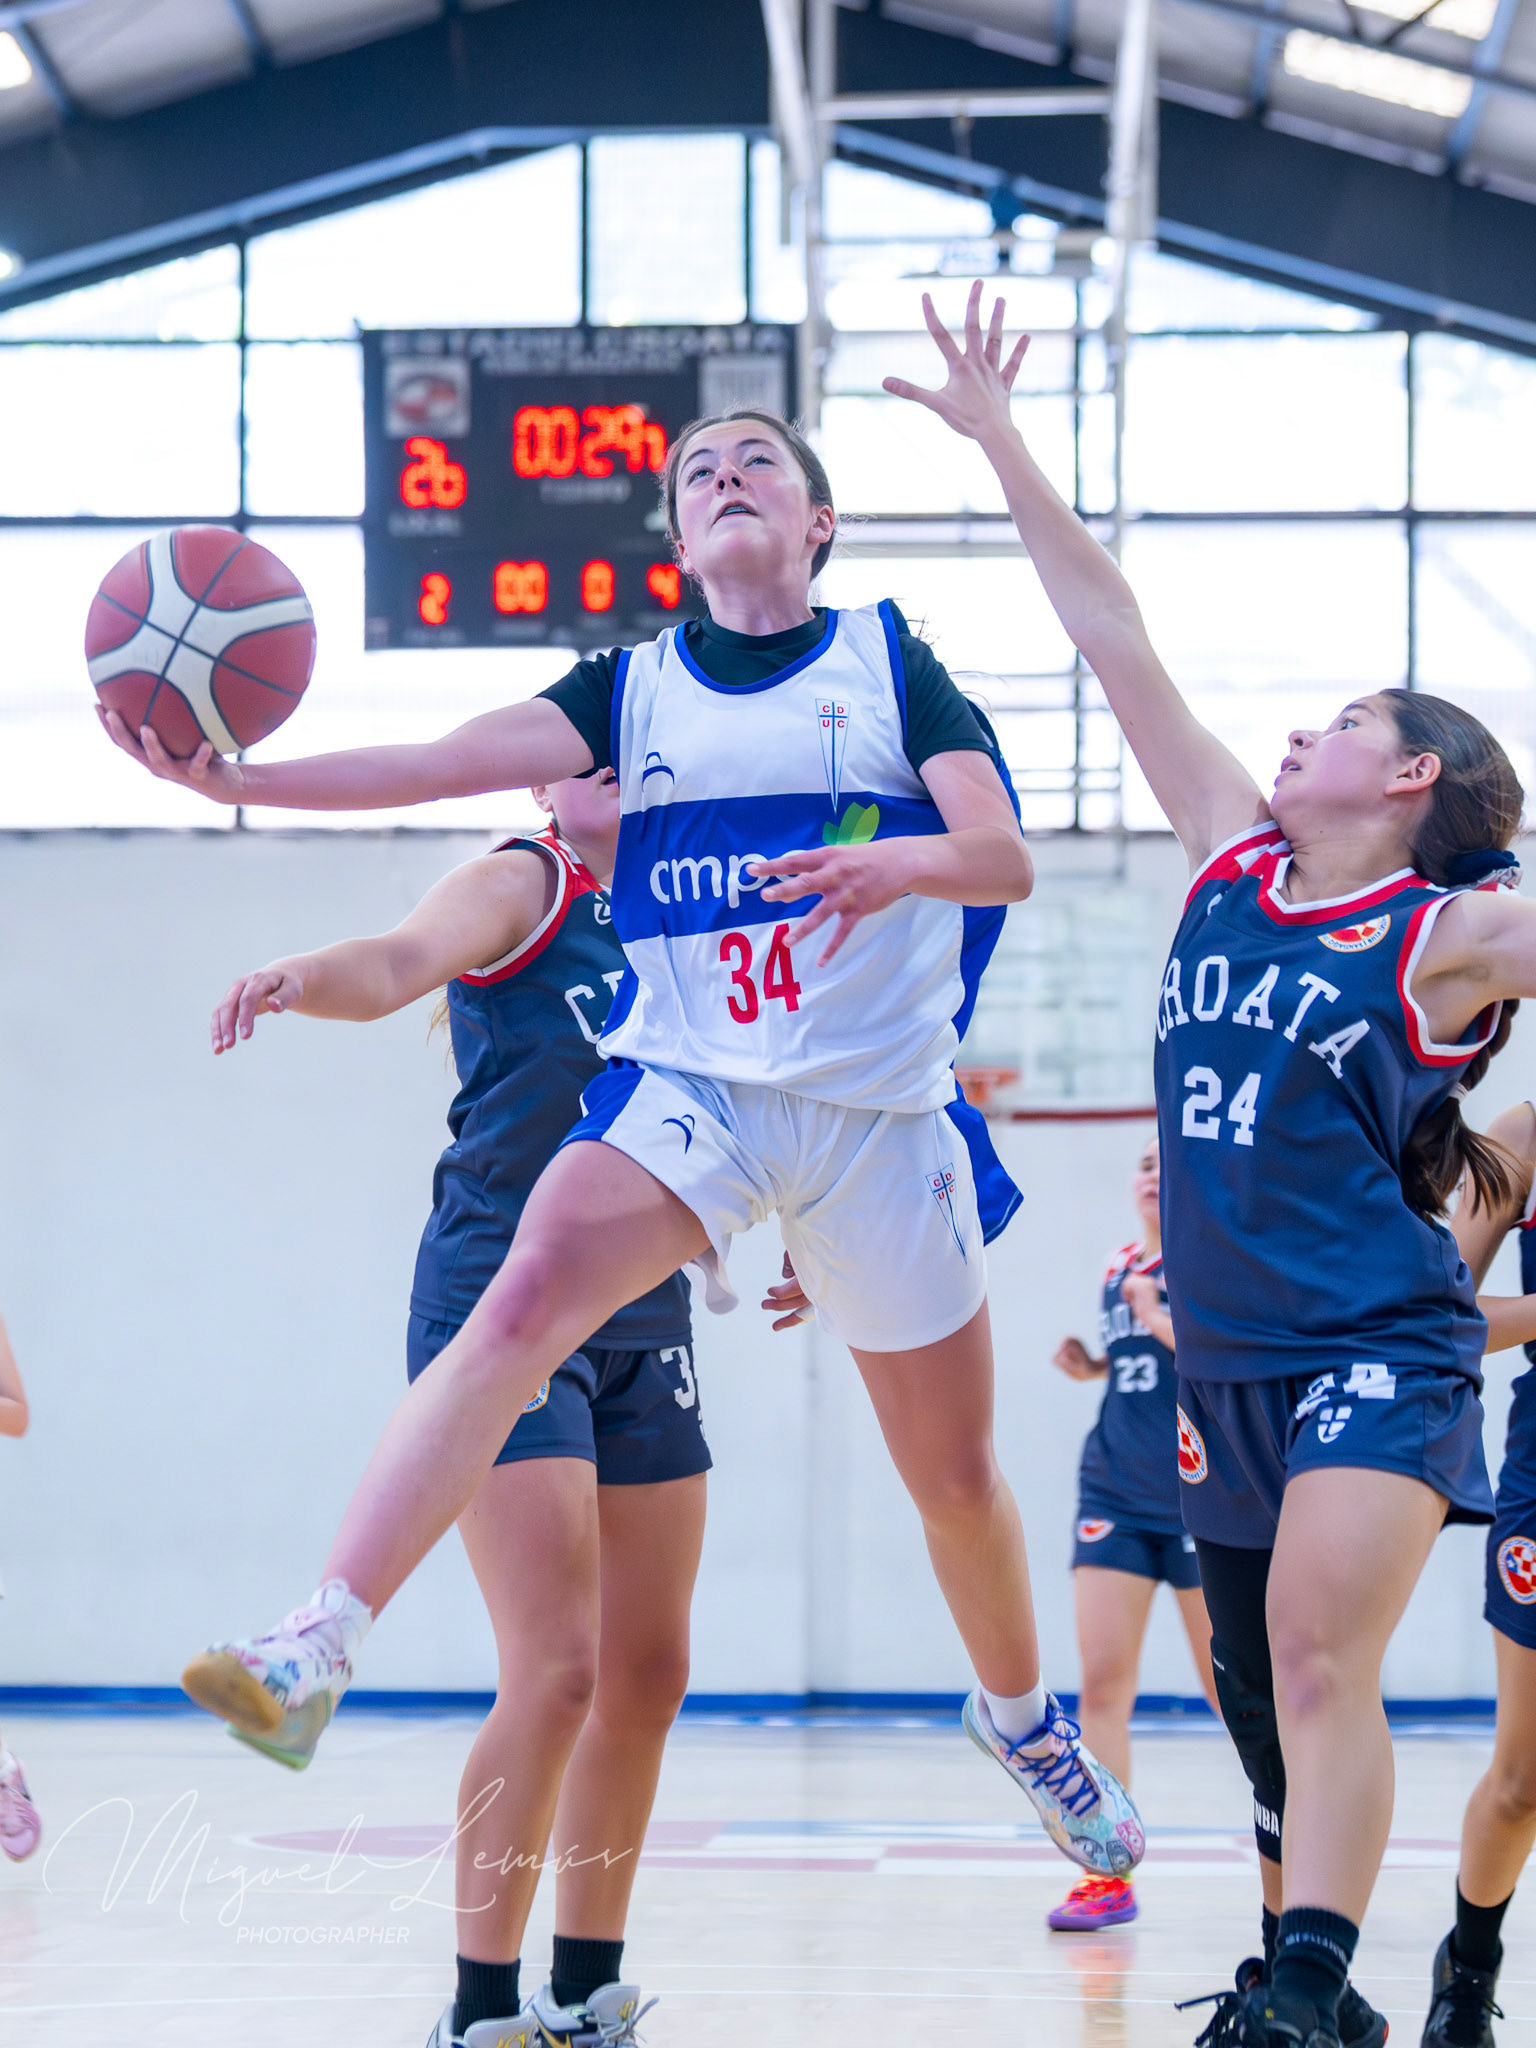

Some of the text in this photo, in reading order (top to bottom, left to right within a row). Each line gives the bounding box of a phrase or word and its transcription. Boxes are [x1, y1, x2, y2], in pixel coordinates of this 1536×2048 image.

[419, 572, 452, 625] 2
[719, 922, 802, 1024] 34
[1182, 1065, 1261, 1147] 24
[1113, 1353, 1159, 1393] 23
[1254, 1800, 1281, 1838] NBA
